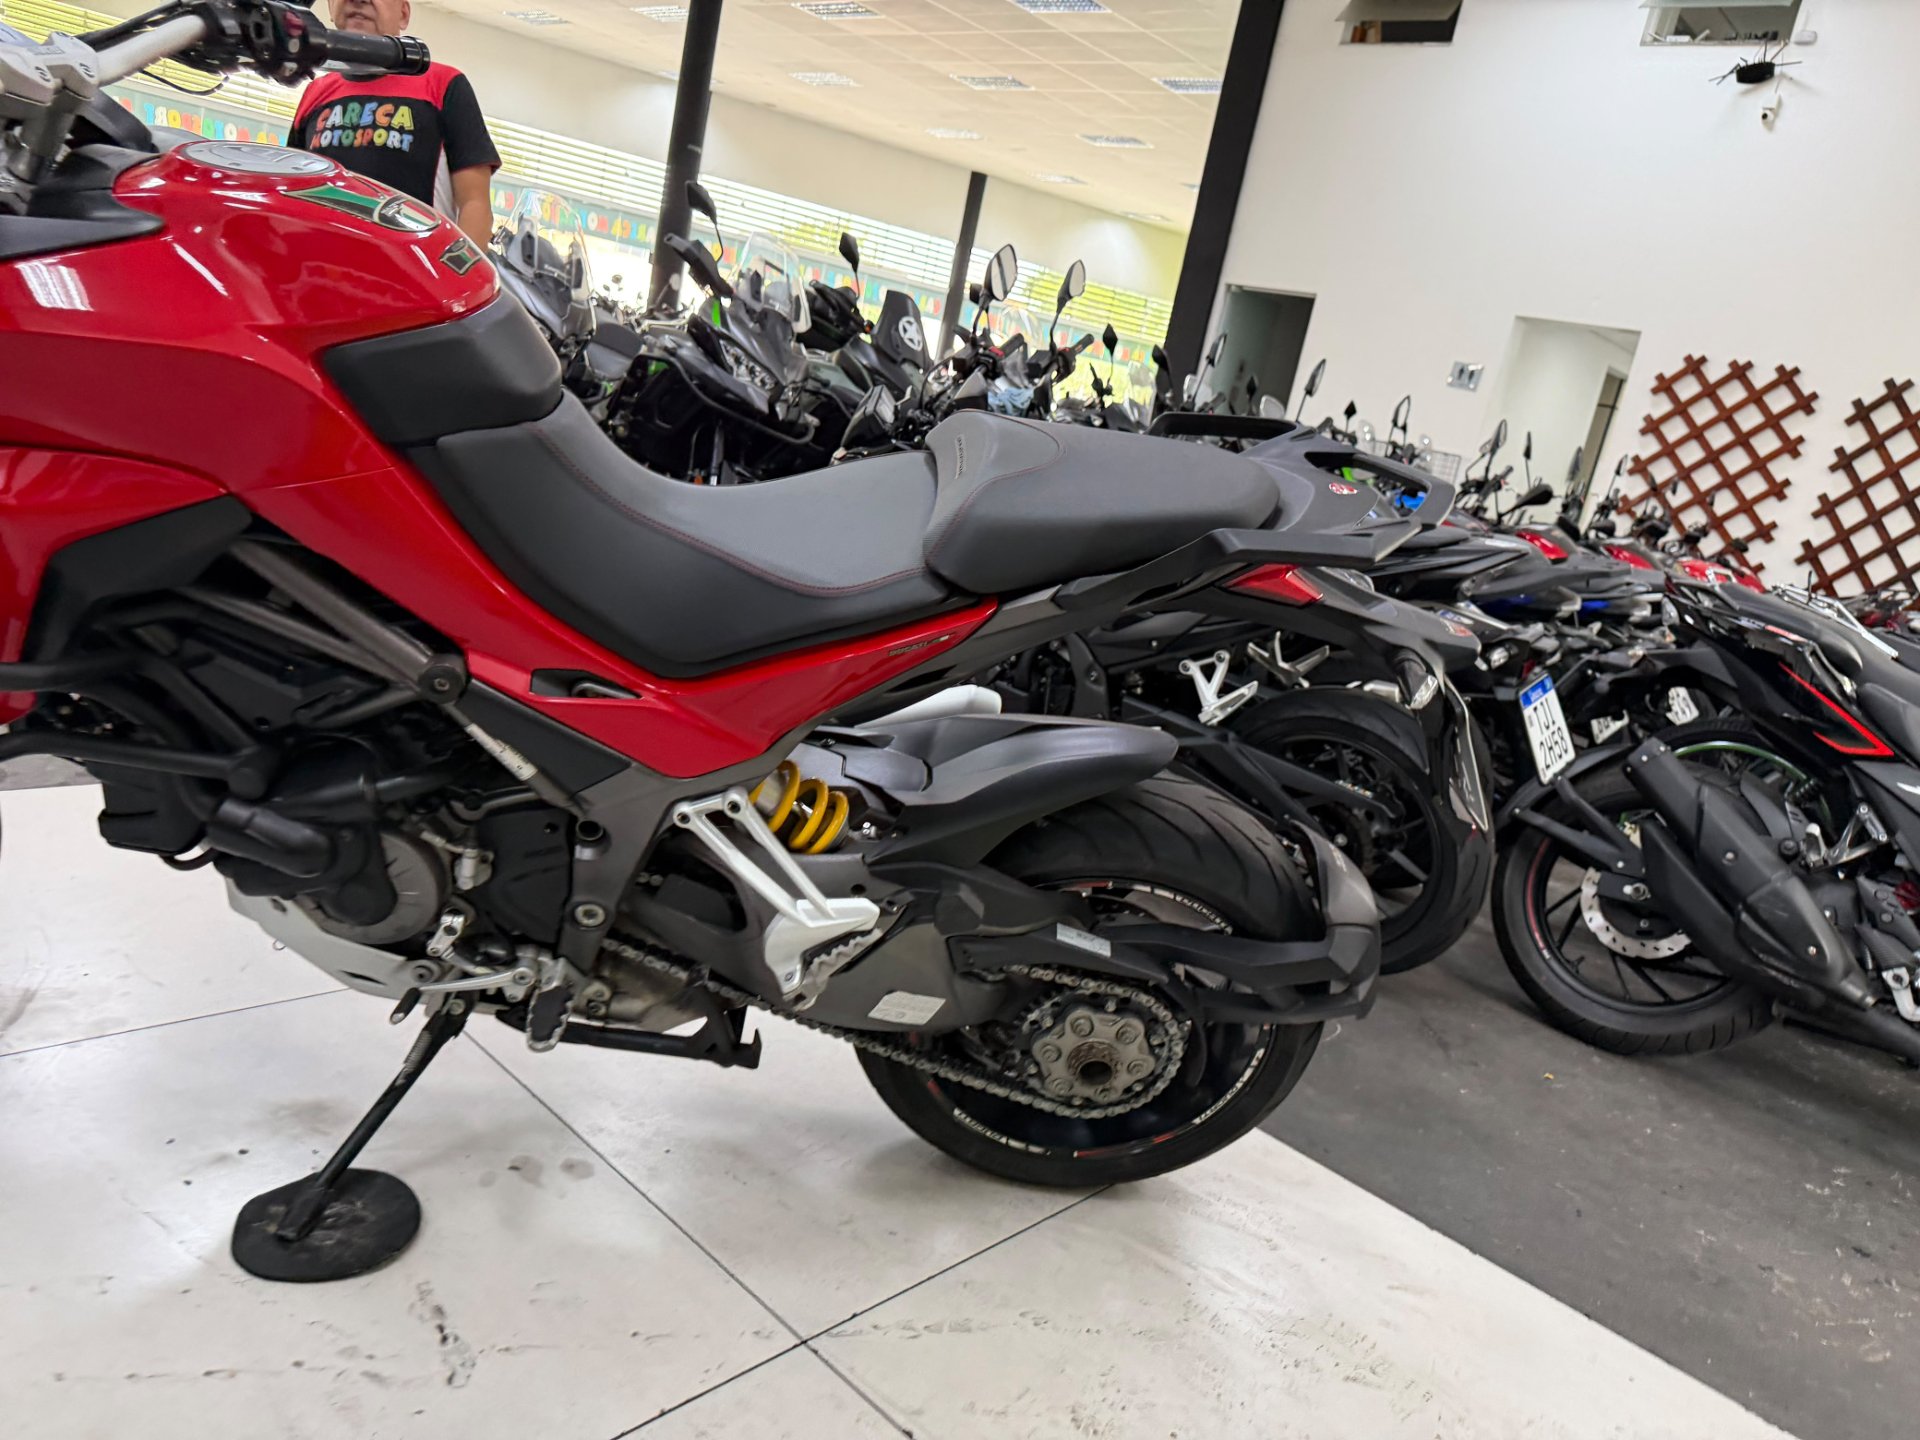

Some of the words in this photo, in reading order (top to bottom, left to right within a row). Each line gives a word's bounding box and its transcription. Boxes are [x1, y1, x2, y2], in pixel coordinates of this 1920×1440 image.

[316, 101, 414, 131] CARECA
[310, 128, 414, 152] MOTOSPORT
[1539, 727, 1568, 771] 2H58
